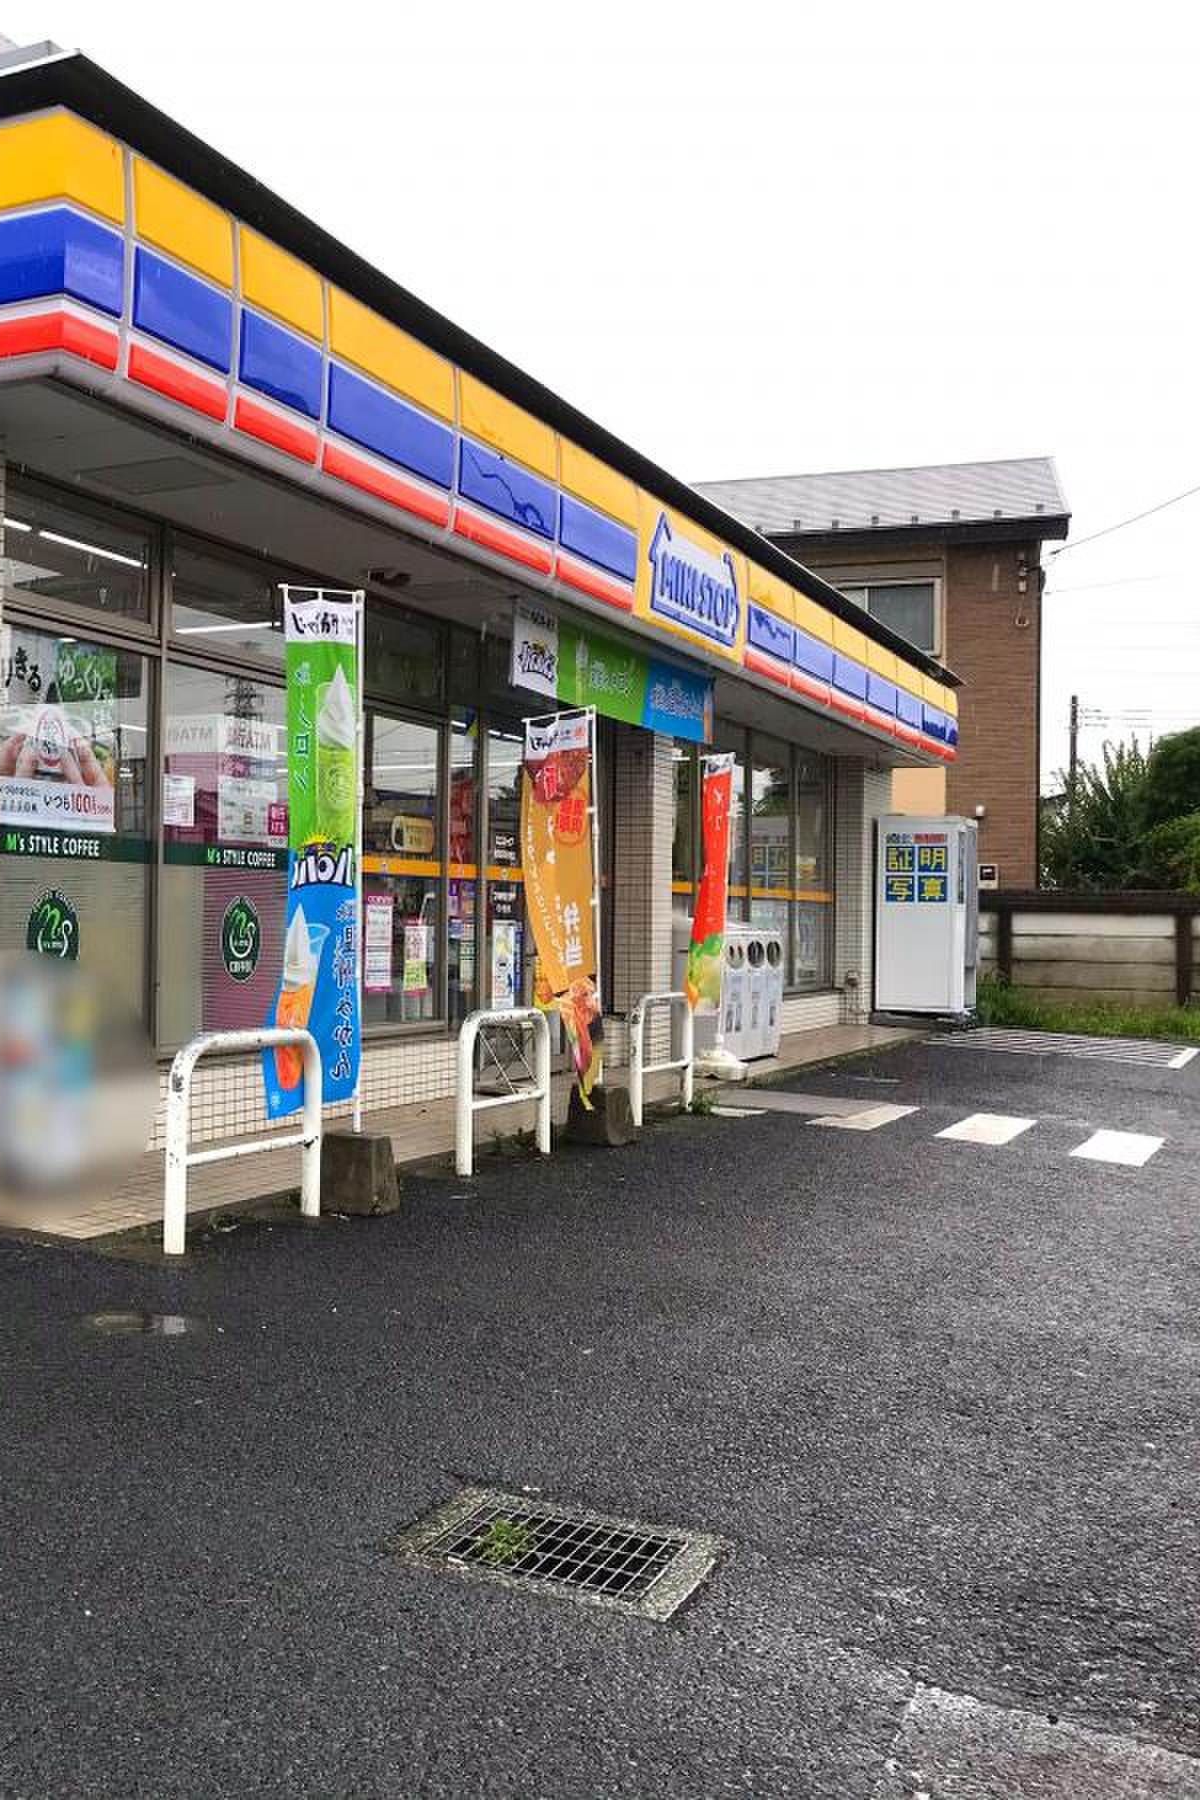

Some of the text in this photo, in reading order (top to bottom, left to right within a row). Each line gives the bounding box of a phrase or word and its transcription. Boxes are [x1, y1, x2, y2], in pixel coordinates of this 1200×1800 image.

[6, 833, 100, 857] M's STYLE COFFEE
[207, 848, 276, 868] M's STYLE COFFEE
